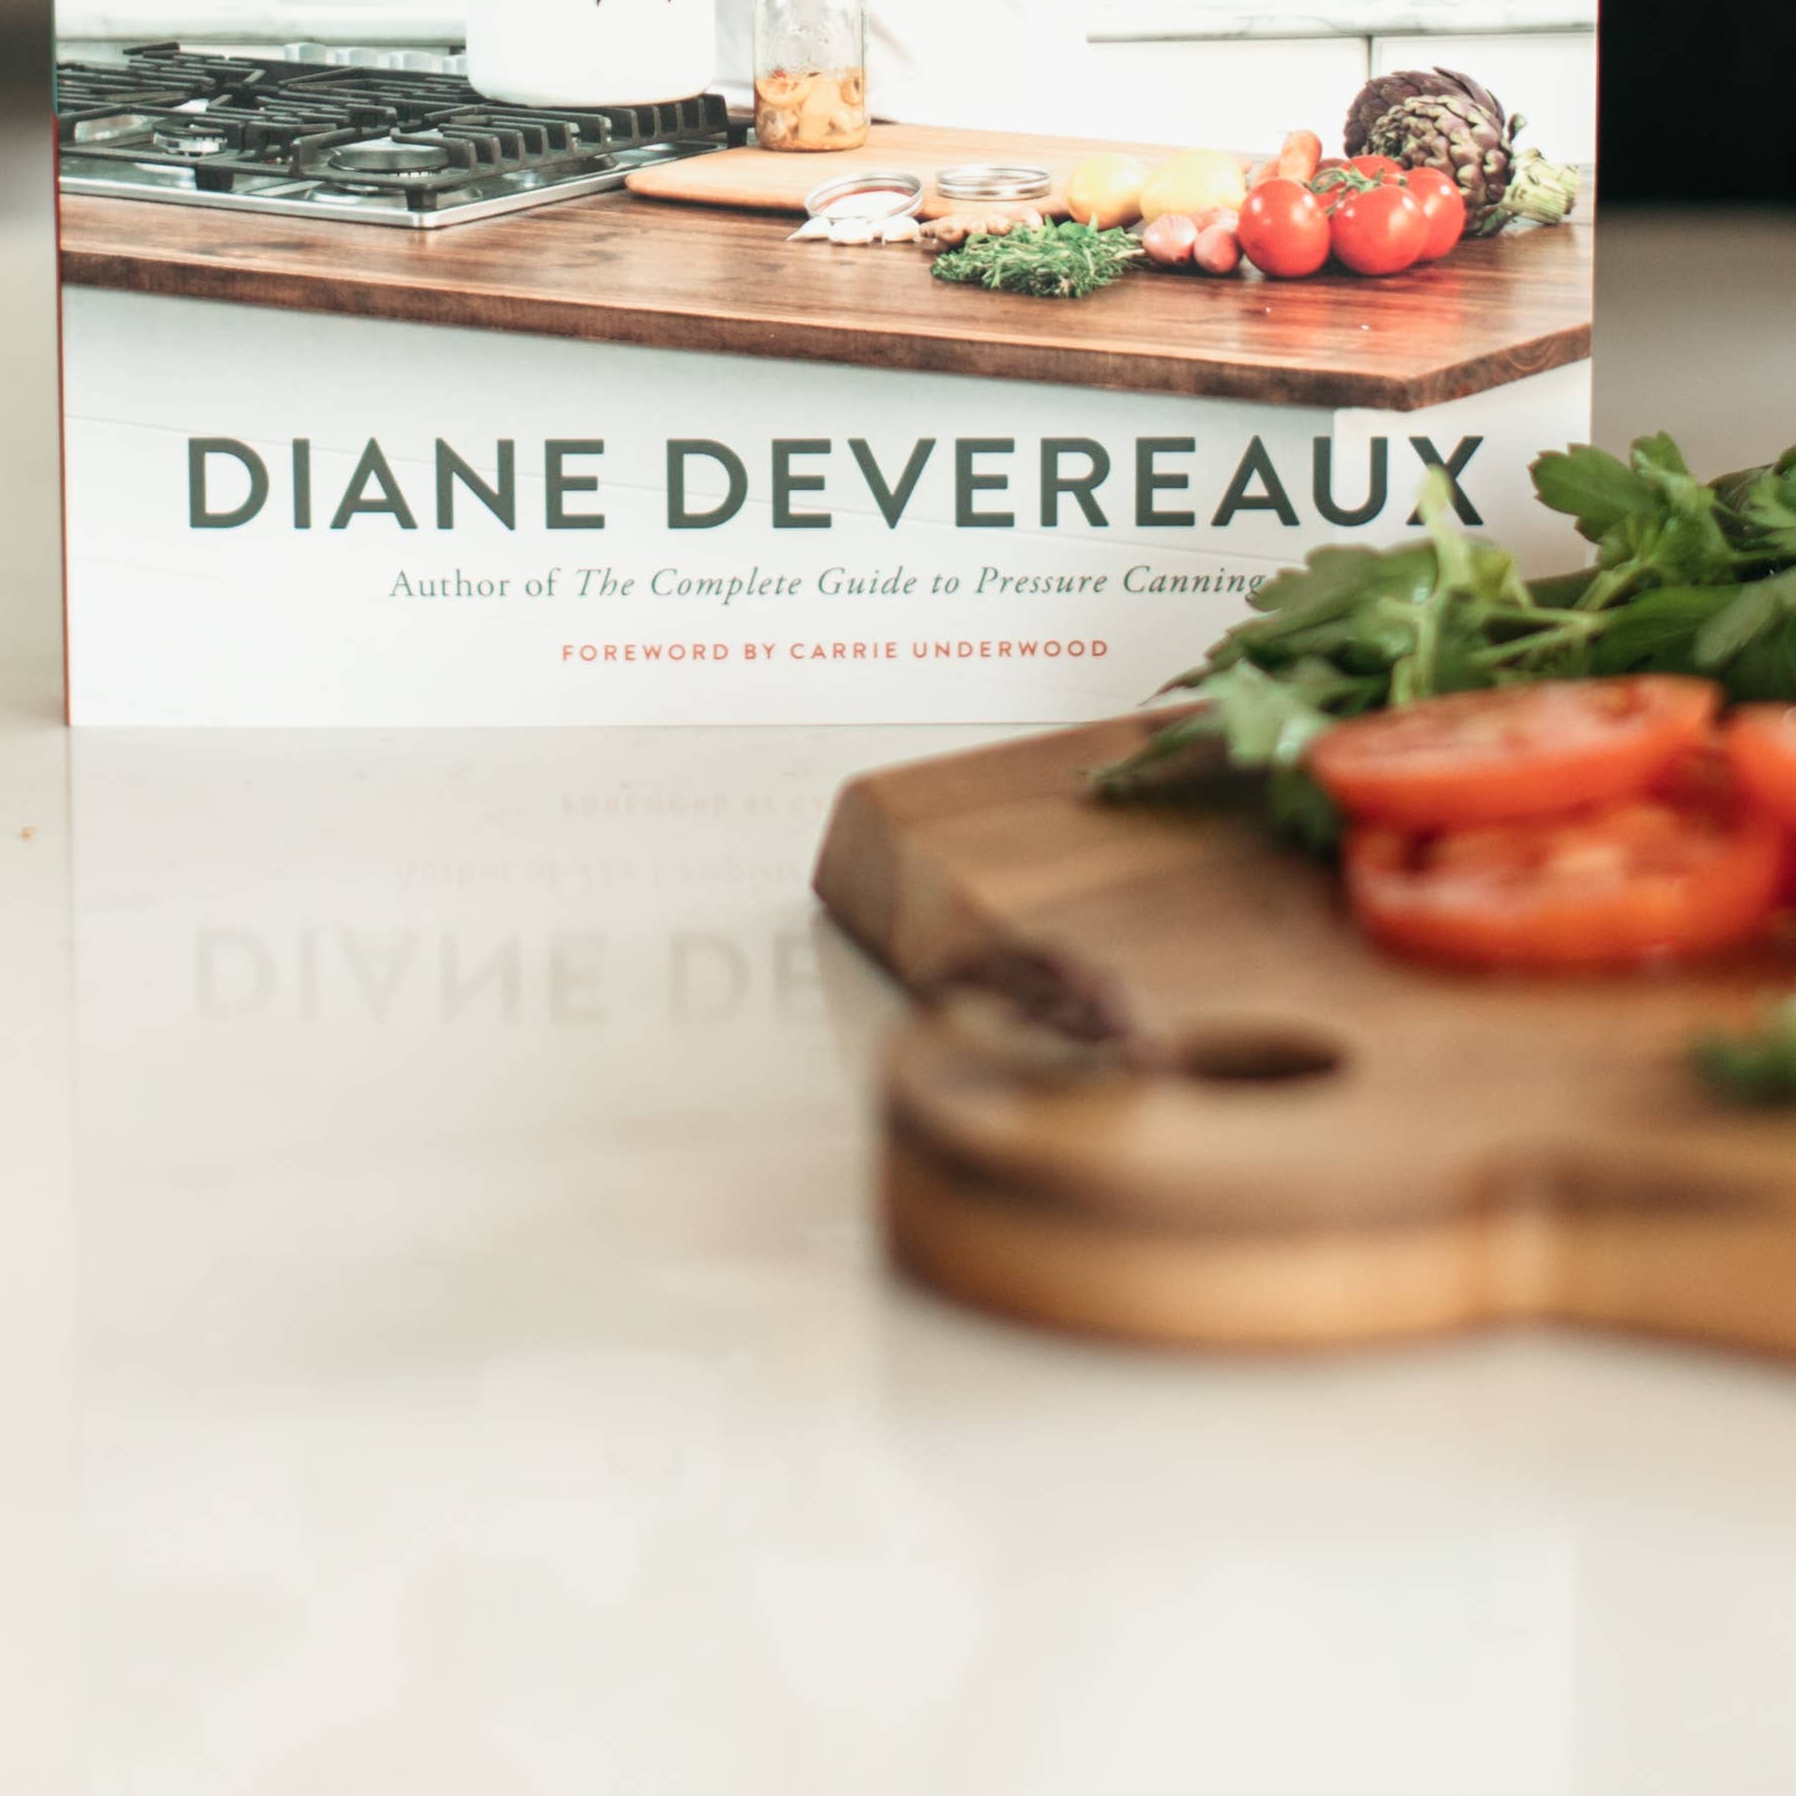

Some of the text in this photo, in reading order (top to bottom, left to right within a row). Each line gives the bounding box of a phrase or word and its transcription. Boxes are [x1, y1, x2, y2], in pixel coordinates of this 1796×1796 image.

[185, 432, 1487, 534] DIANE DEVEREAUX
[388, 563, 1266, 607] Author of The Complete Guide to Pressure Canning
[560, 637, 1112, 665] FOREWORD BY CARRIE UNDERWOOD
